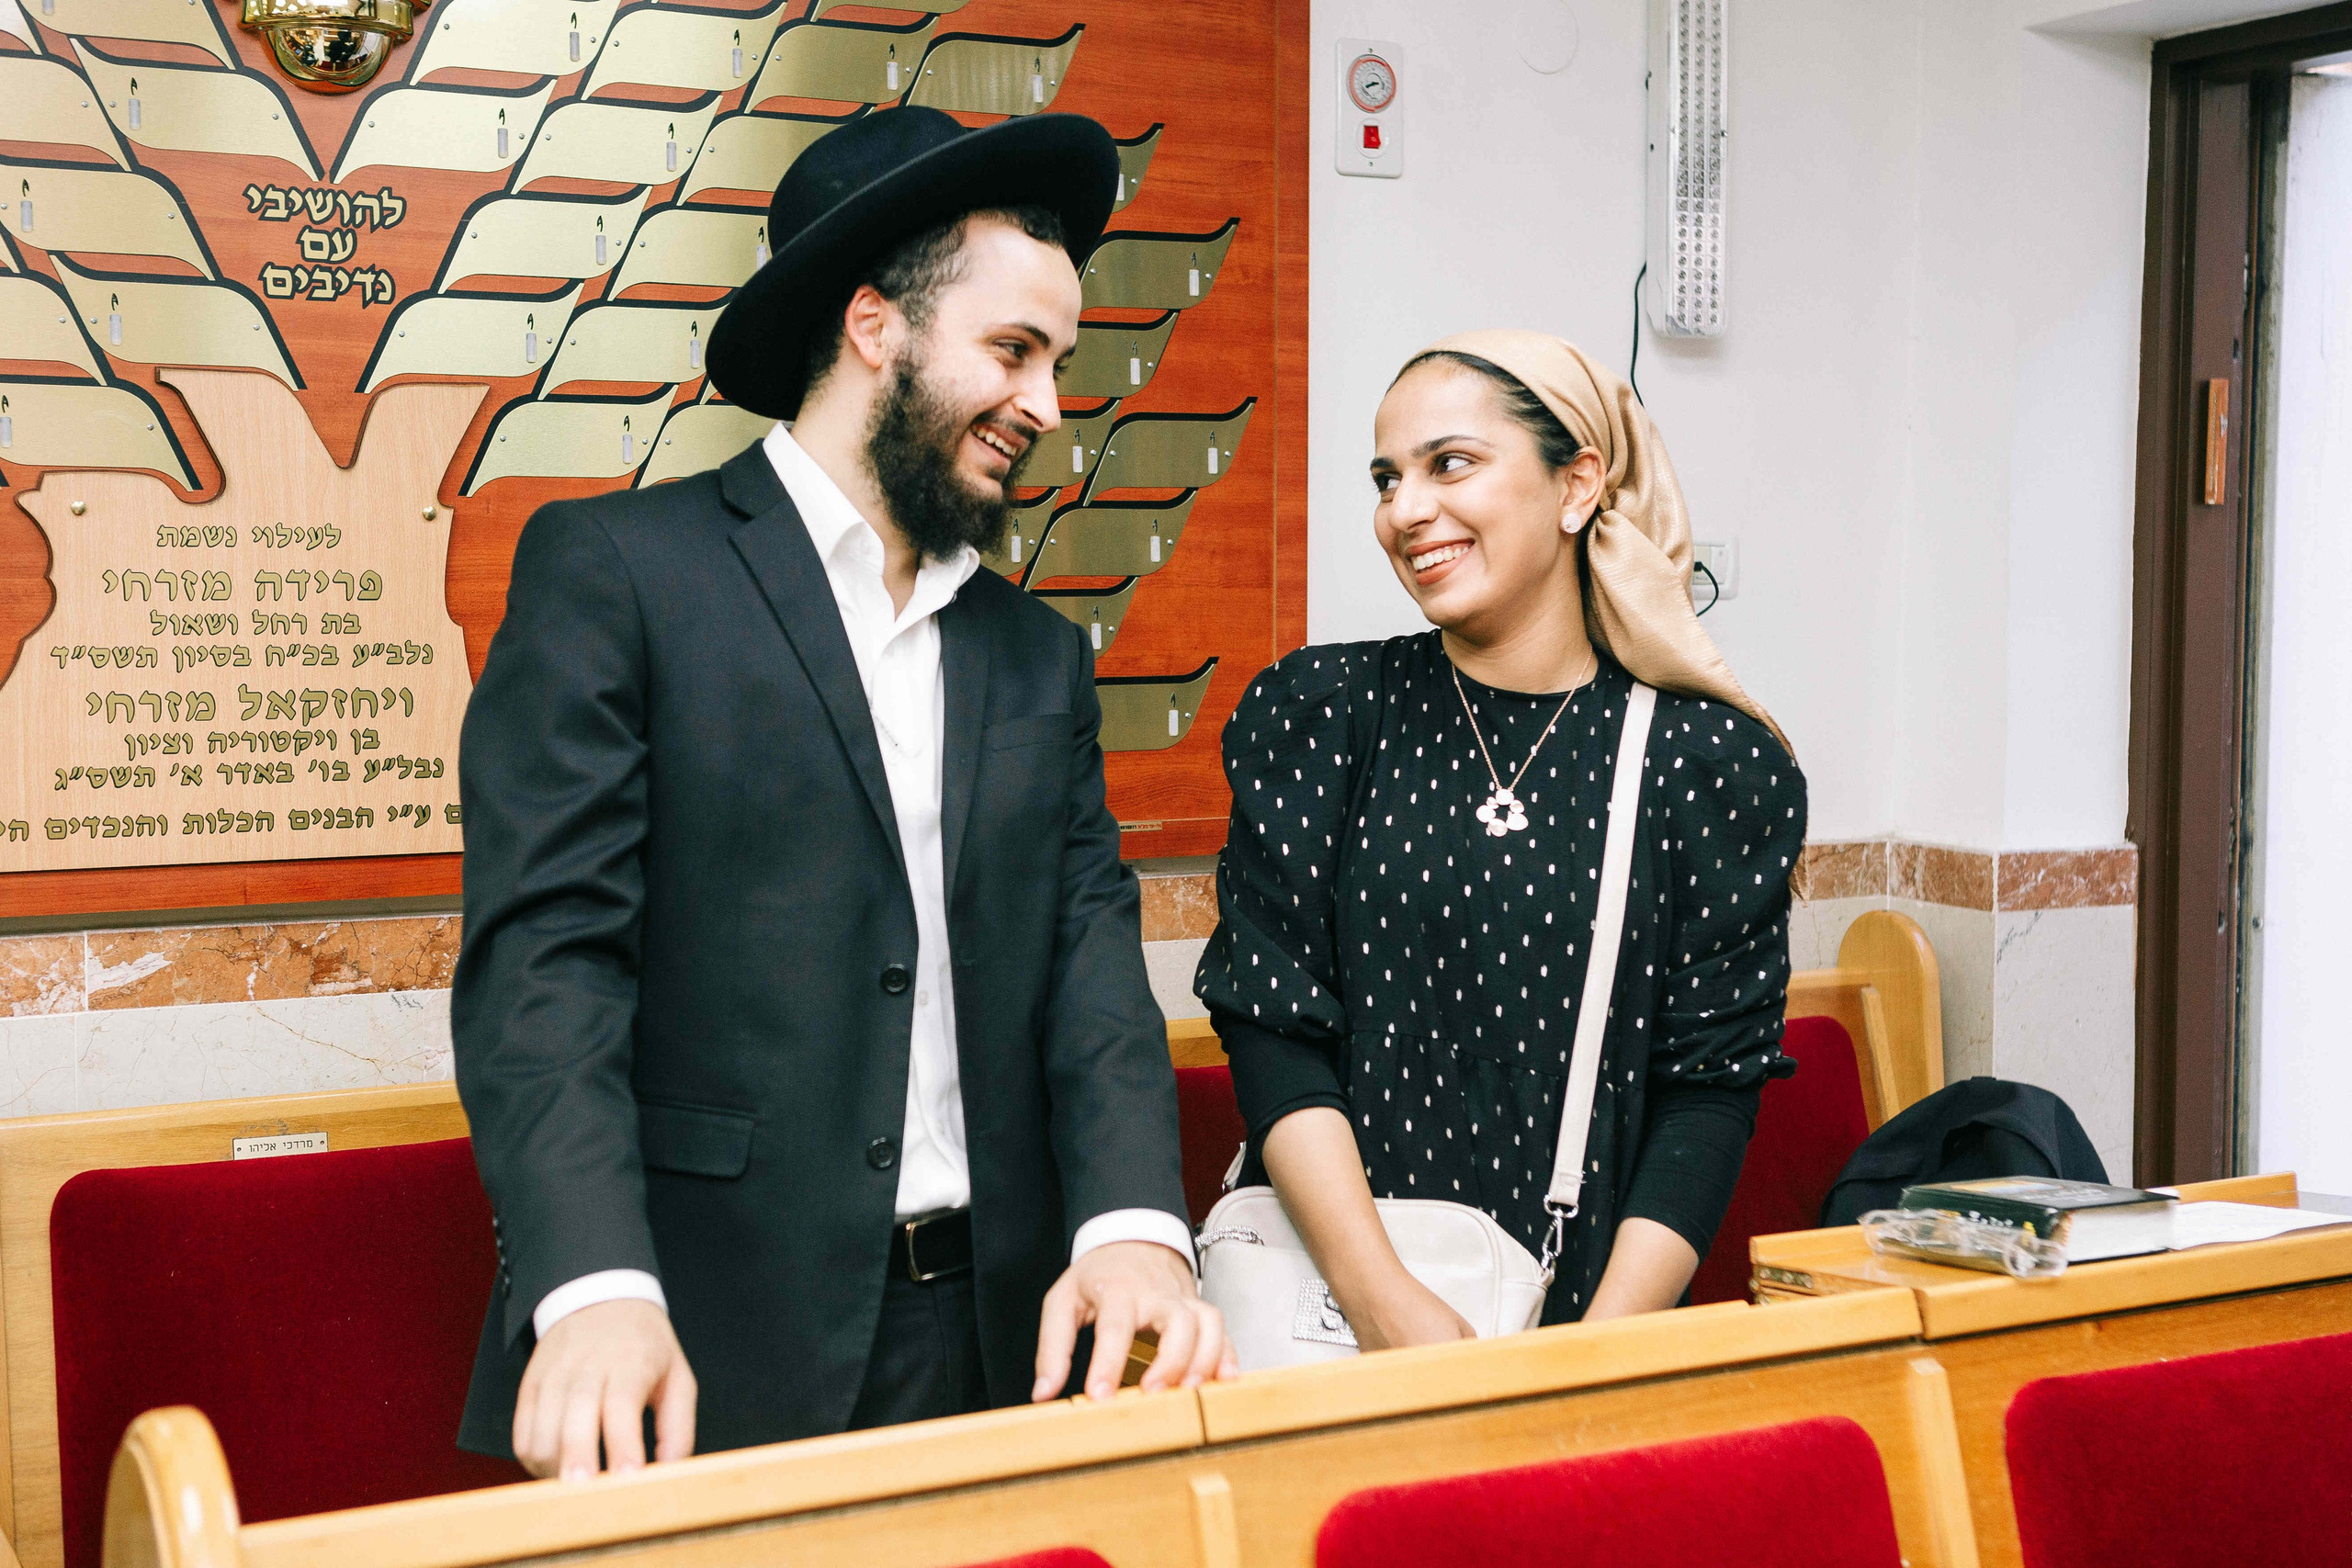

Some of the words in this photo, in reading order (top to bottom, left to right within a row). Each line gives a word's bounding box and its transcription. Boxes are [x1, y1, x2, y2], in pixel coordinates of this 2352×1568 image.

[243, 184, 407, 233] להושיבי
[295, 225, 357, 264] עם
[258, 262, 396, 310] נדיבים
[157, 525, 237, 547] נשמת
[252, 523, 341, 550] לעילוי
[102, 569, 232, 602] מזרחי
[254, 570, 382, 602] פרידה
[150, 610, 238, 636] ושאול
[252, 609, 307, 635] רחל
[322, 613, 361, 635] בת
[172, 645, 252, 673] בסיון
[85, 691, 216, 724] מזרחי
[238, 683, 413, 727] ויחזקאל
[124, 733, 193, 761] וציון
[208, 729, 337, 756] ויקטוריה
[350, 728, 380, 755] בן
[217, 761, 295, 784] באדר
[44, 815, 168, 840] והנכדים
[183, 808, 274, 834] הכלות
[288, 807, 374, 830] הבנים
[249, 1143, 277, 1153] אליהו
[283, 1139, 313, 1150] מרדכי
